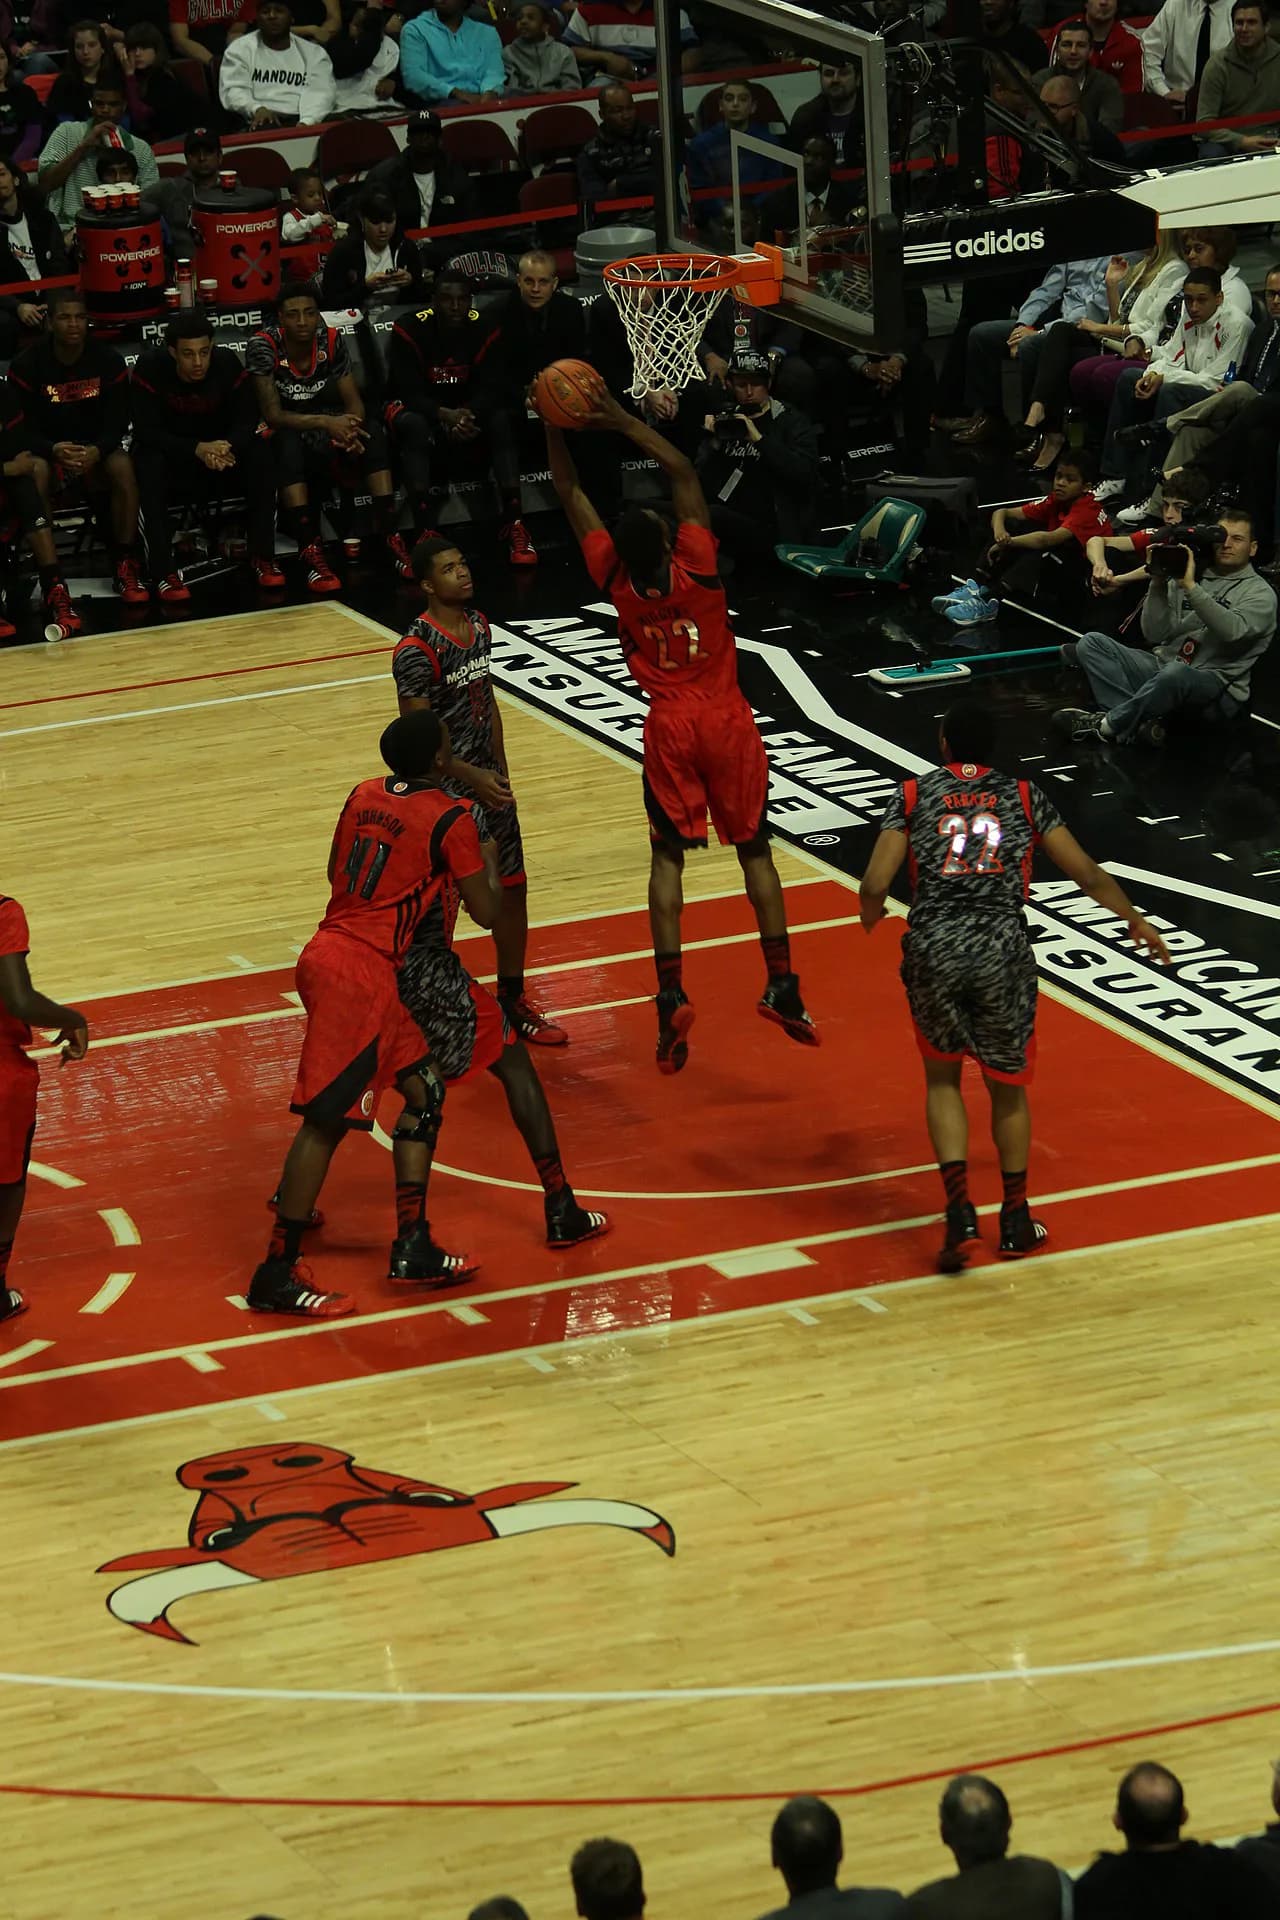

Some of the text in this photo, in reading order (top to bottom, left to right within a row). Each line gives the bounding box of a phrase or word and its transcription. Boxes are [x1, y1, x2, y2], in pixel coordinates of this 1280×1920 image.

[215, 218, 278, 234] POWERADE
[954, 228, 1045, 258] adidas
[100, 246, 161, 263] POWERADE
[760, 730, 897, 816] FAMIL
[344, 831, 393, 900] 41
[938, 812, 1005, 876] 22
